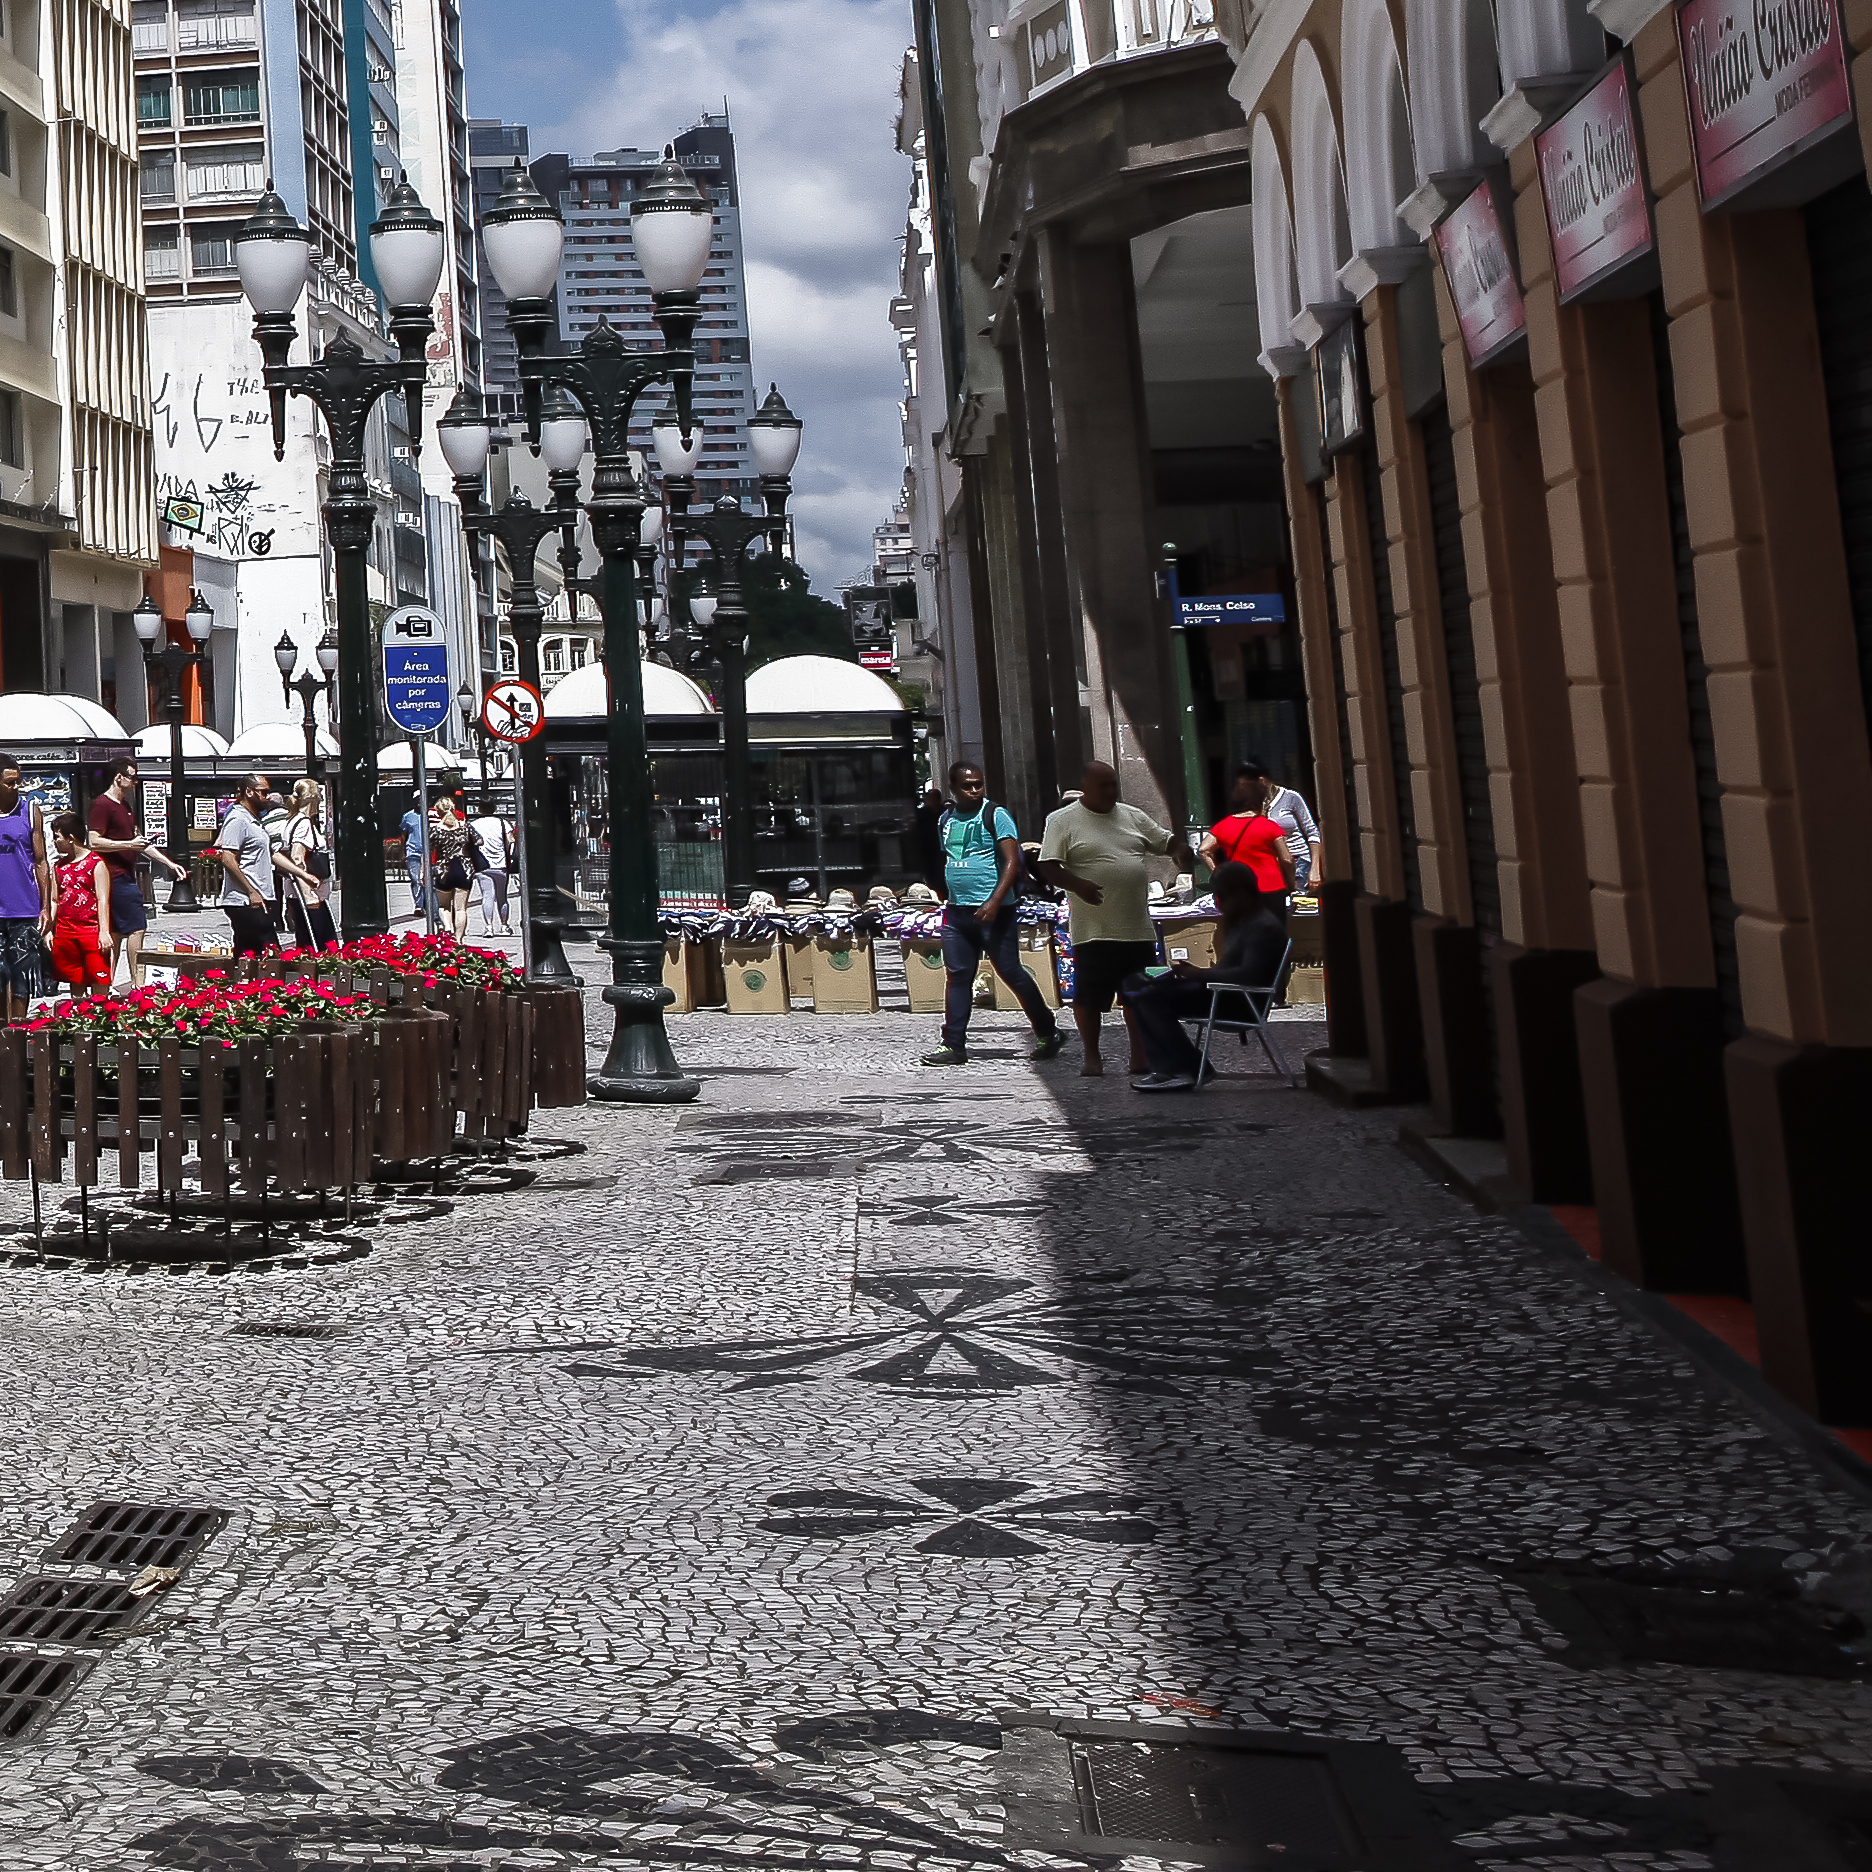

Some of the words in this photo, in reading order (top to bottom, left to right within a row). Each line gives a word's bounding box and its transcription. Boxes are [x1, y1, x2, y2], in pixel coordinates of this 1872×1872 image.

[1225, 601, 1256, 610] Celso
[403, 659, 430, 671] Área
[387, 674, 447, 685] monitorada
[408, 688, 427, 699] por
